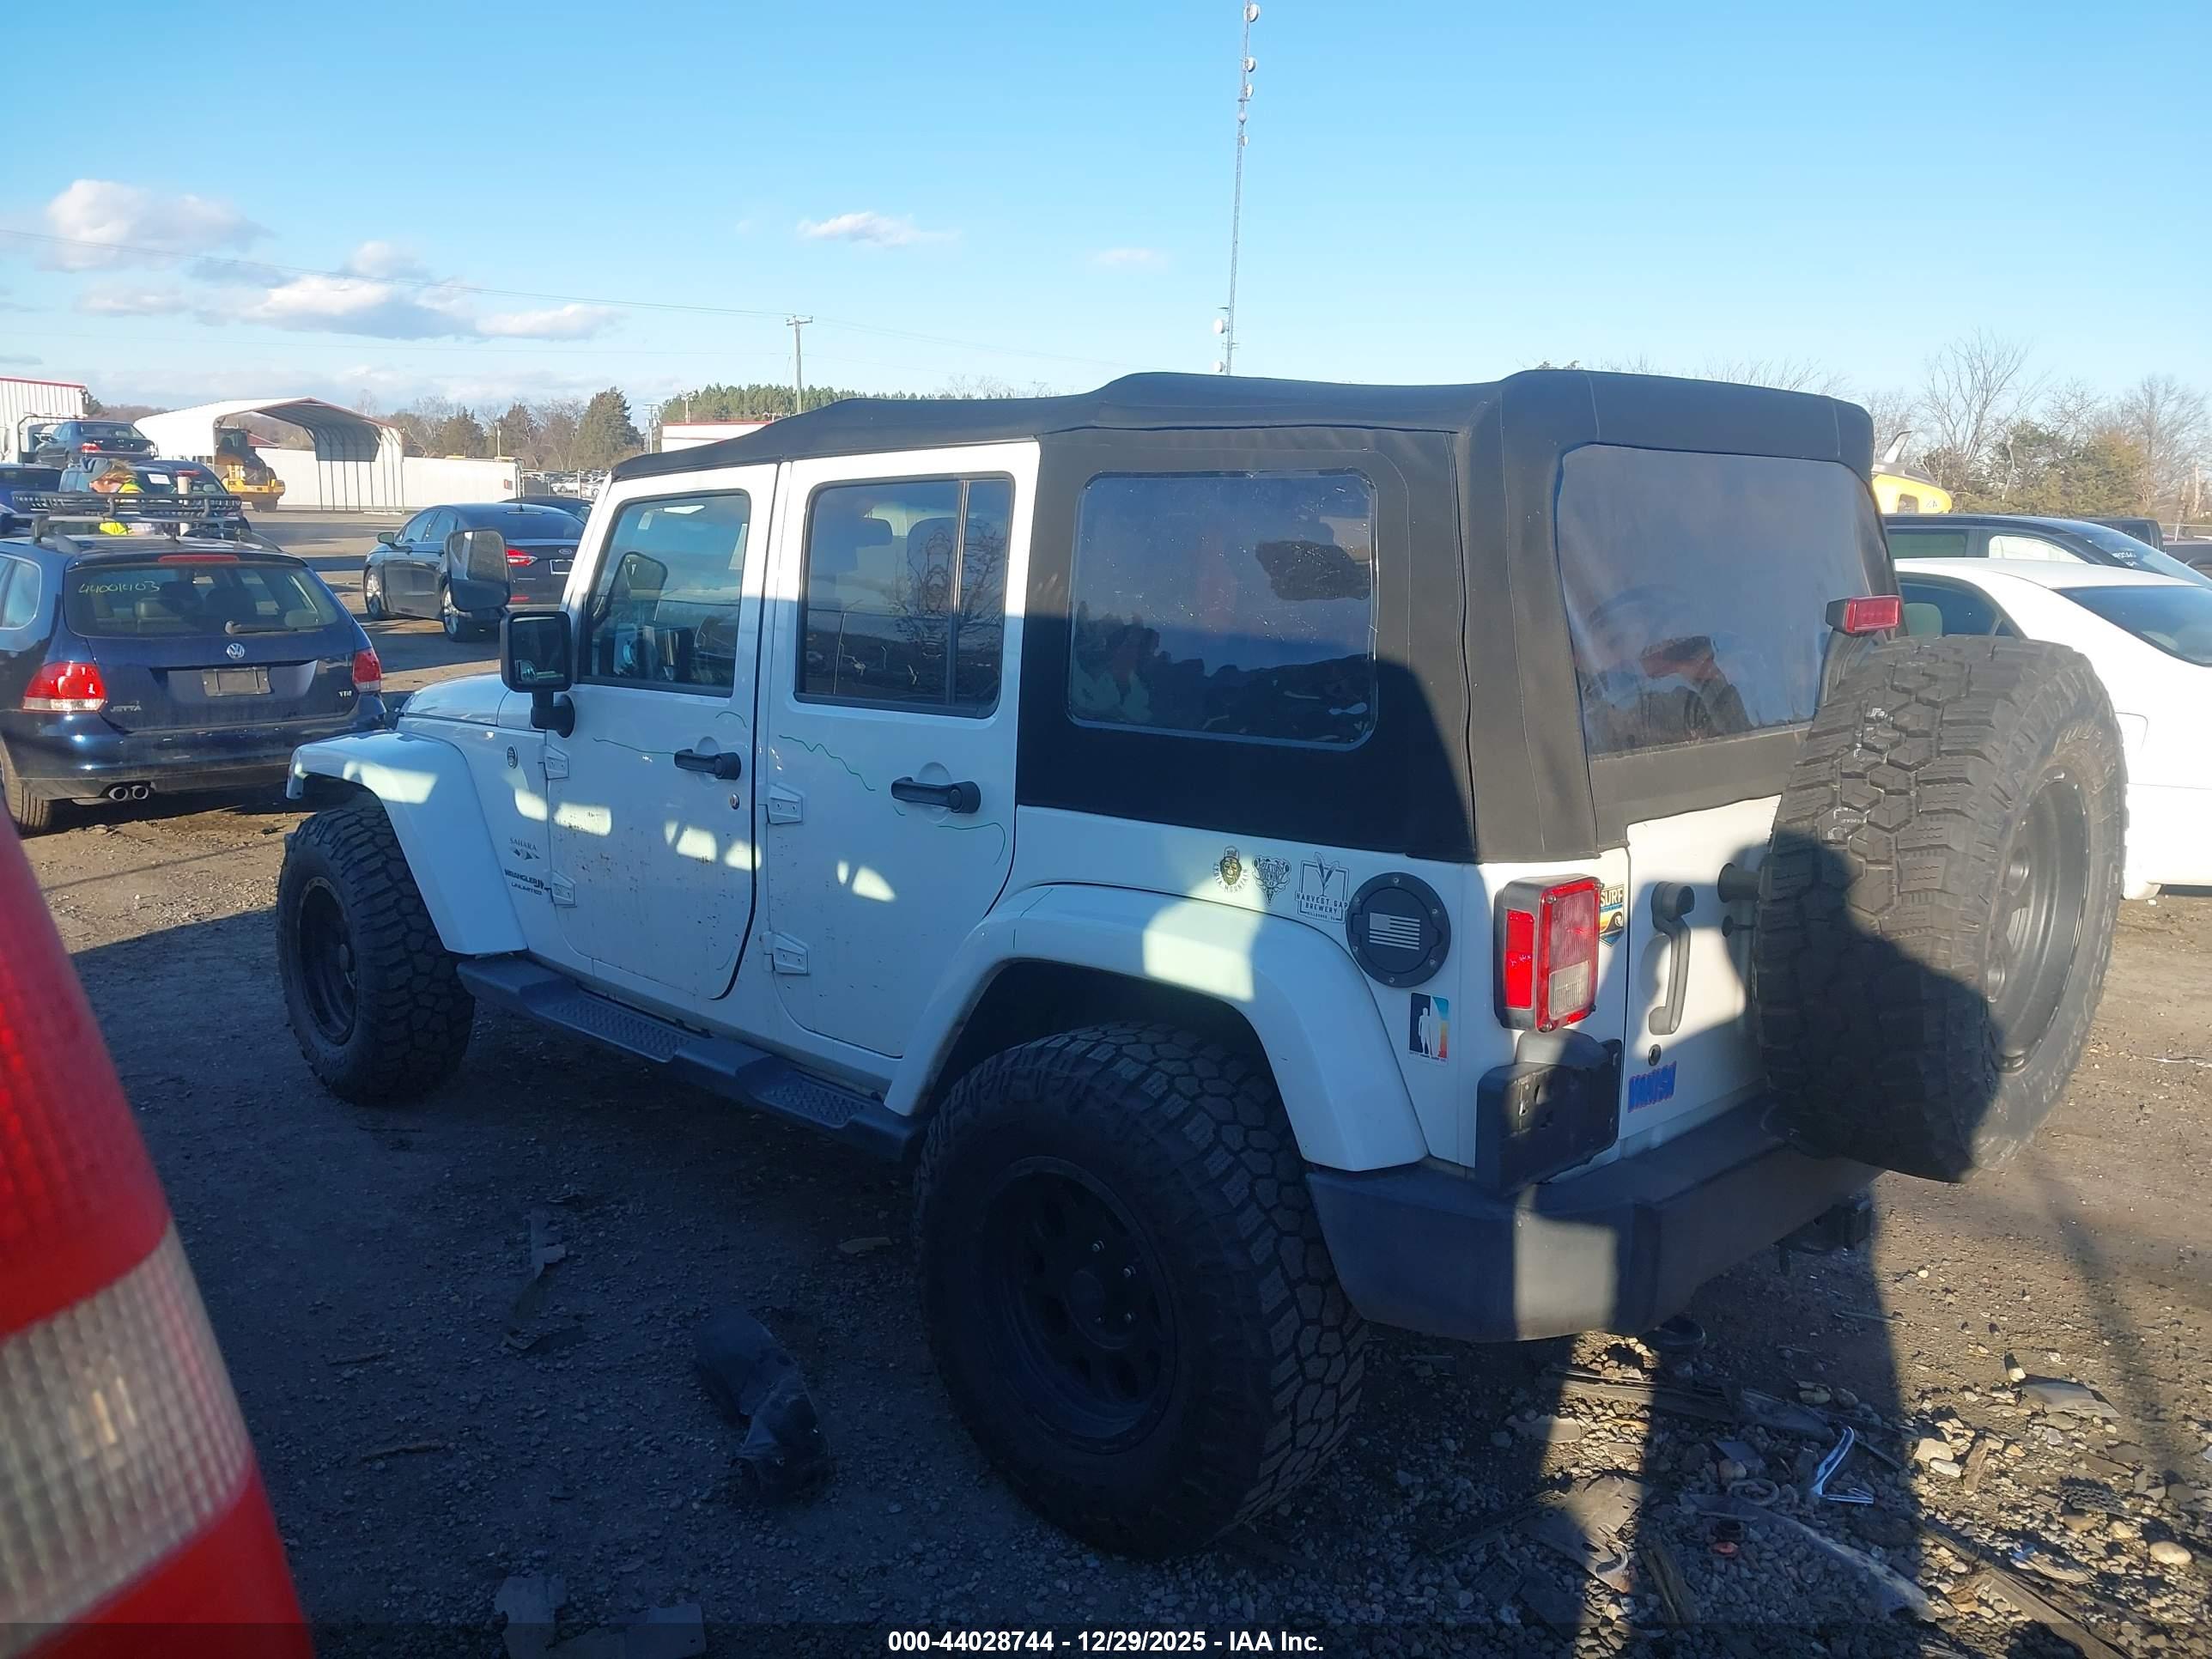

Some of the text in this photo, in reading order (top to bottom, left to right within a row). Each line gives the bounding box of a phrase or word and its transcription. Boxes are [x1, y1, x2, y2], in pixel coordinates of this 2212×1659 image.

[110, 704, 143, 713] JETTA
[1296, 892, 1348, 909] HARVEST GAP
[1600, 887, 1623, 908] SURF
[1305, 902, 1338, 915] BREWERY
